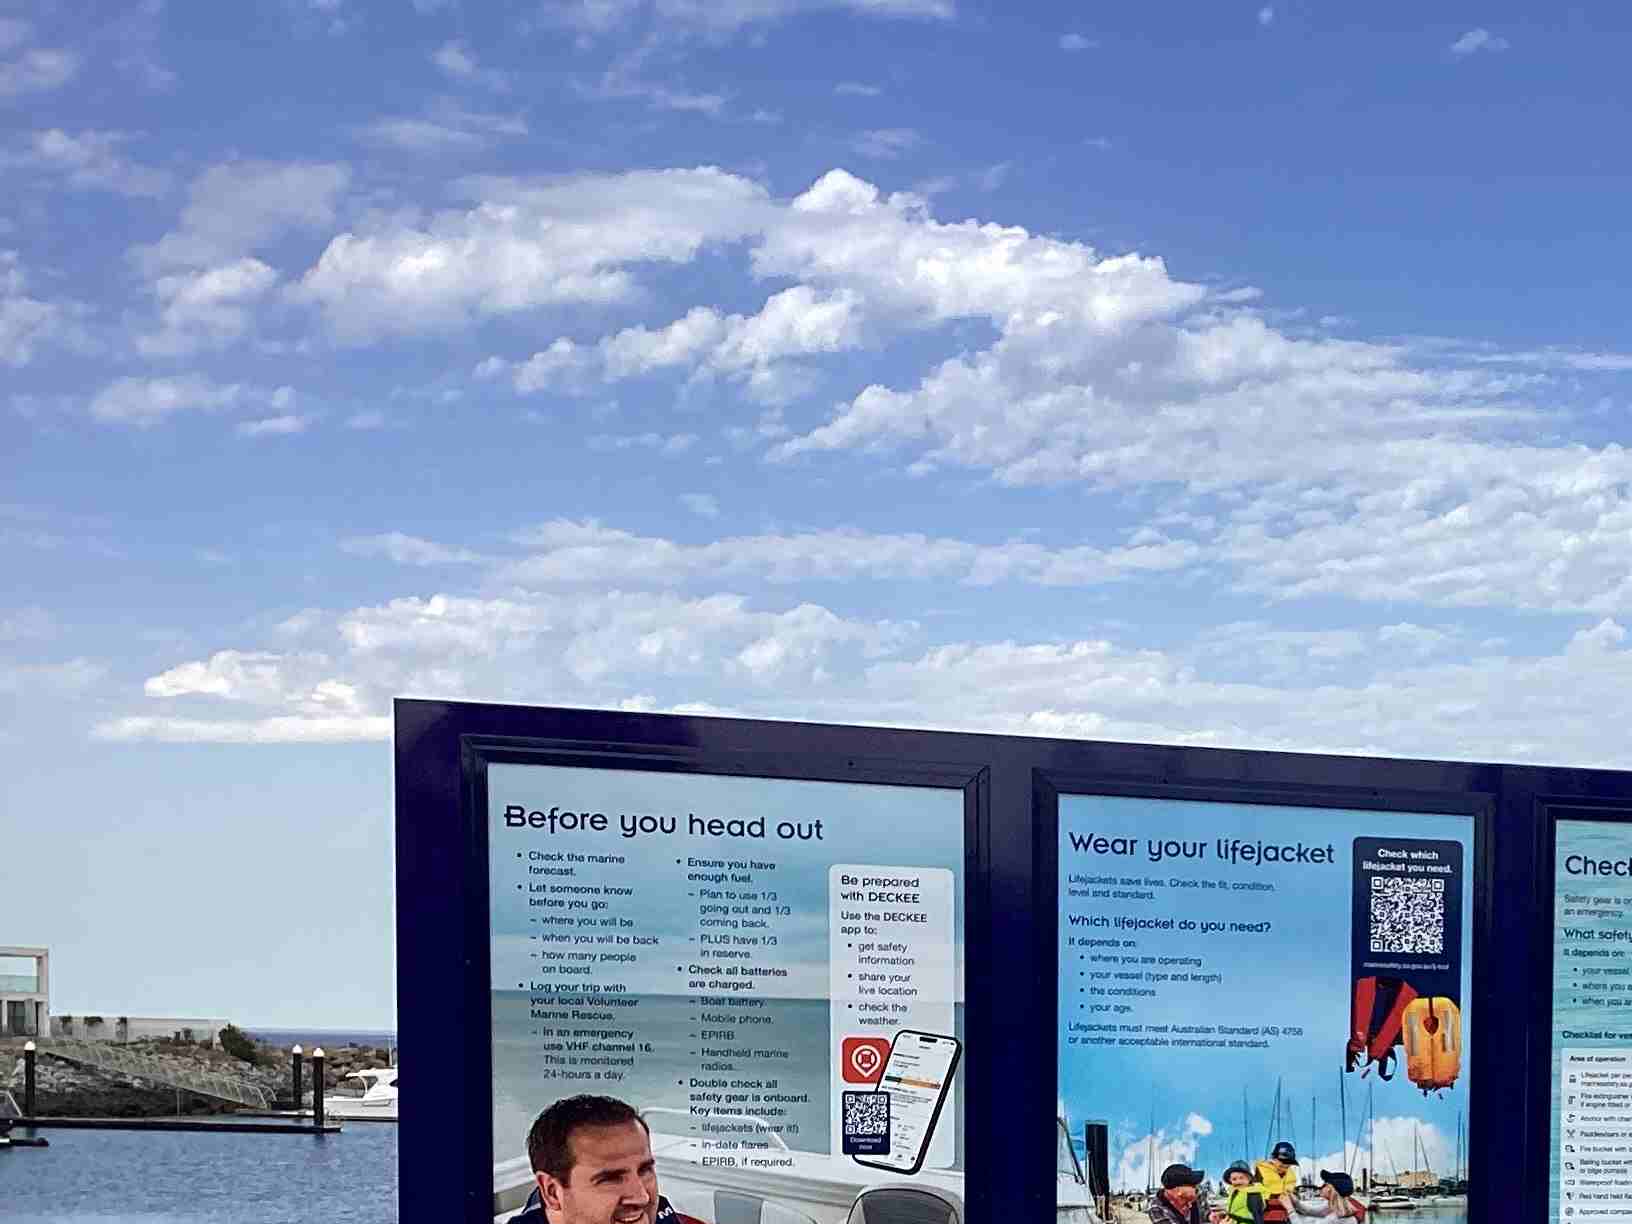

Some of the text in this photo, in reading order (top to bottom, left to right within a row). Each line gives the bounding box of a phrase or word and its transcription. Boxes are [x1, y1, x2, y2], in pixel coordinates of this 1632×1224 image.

[503, 805, 822, 840] Before you head out
[1069, 831, 1333, 866] Wear your lifejacket
[1377, 848, 1438, 859] Check which
[528, 850, 624, 863] Check the marine
[687, 857, 775, 870] Ensure you have
[1362, 860, 1405, 871] lifejacket
[1407, 864, 1424, 872] you
[687, 872, 728, 884] enough
[841, 874, 919, 888] Be prepared
[529, 882, 632, 895] Let someone know
[840, 891, 919, 903] with DECKEE
[529, 897, 564, 907] before
[567, 900, 588, 910] you
[841, 910, 927, 922] Use the DECKEE
[542, 917, 633, 928] where you will be
[1068, 914, 1271, 935] Which lifejacket do you need?
[841, 926, 861, 935] app
[1563, 927, 1594, 941] What
[542, 932, 658, 944] when you will be back
[688, 964, 787, 977] Check all batteries
[688, 980, 705, 988] are
[690, 1078, 777, 1088] Double check all
[689, 1092, 722, 1103] safety
[725, 1094, 749, 1103] gear
[690, 1105, 710, 1117] Key
[713, 1106, 742, 1115] items
